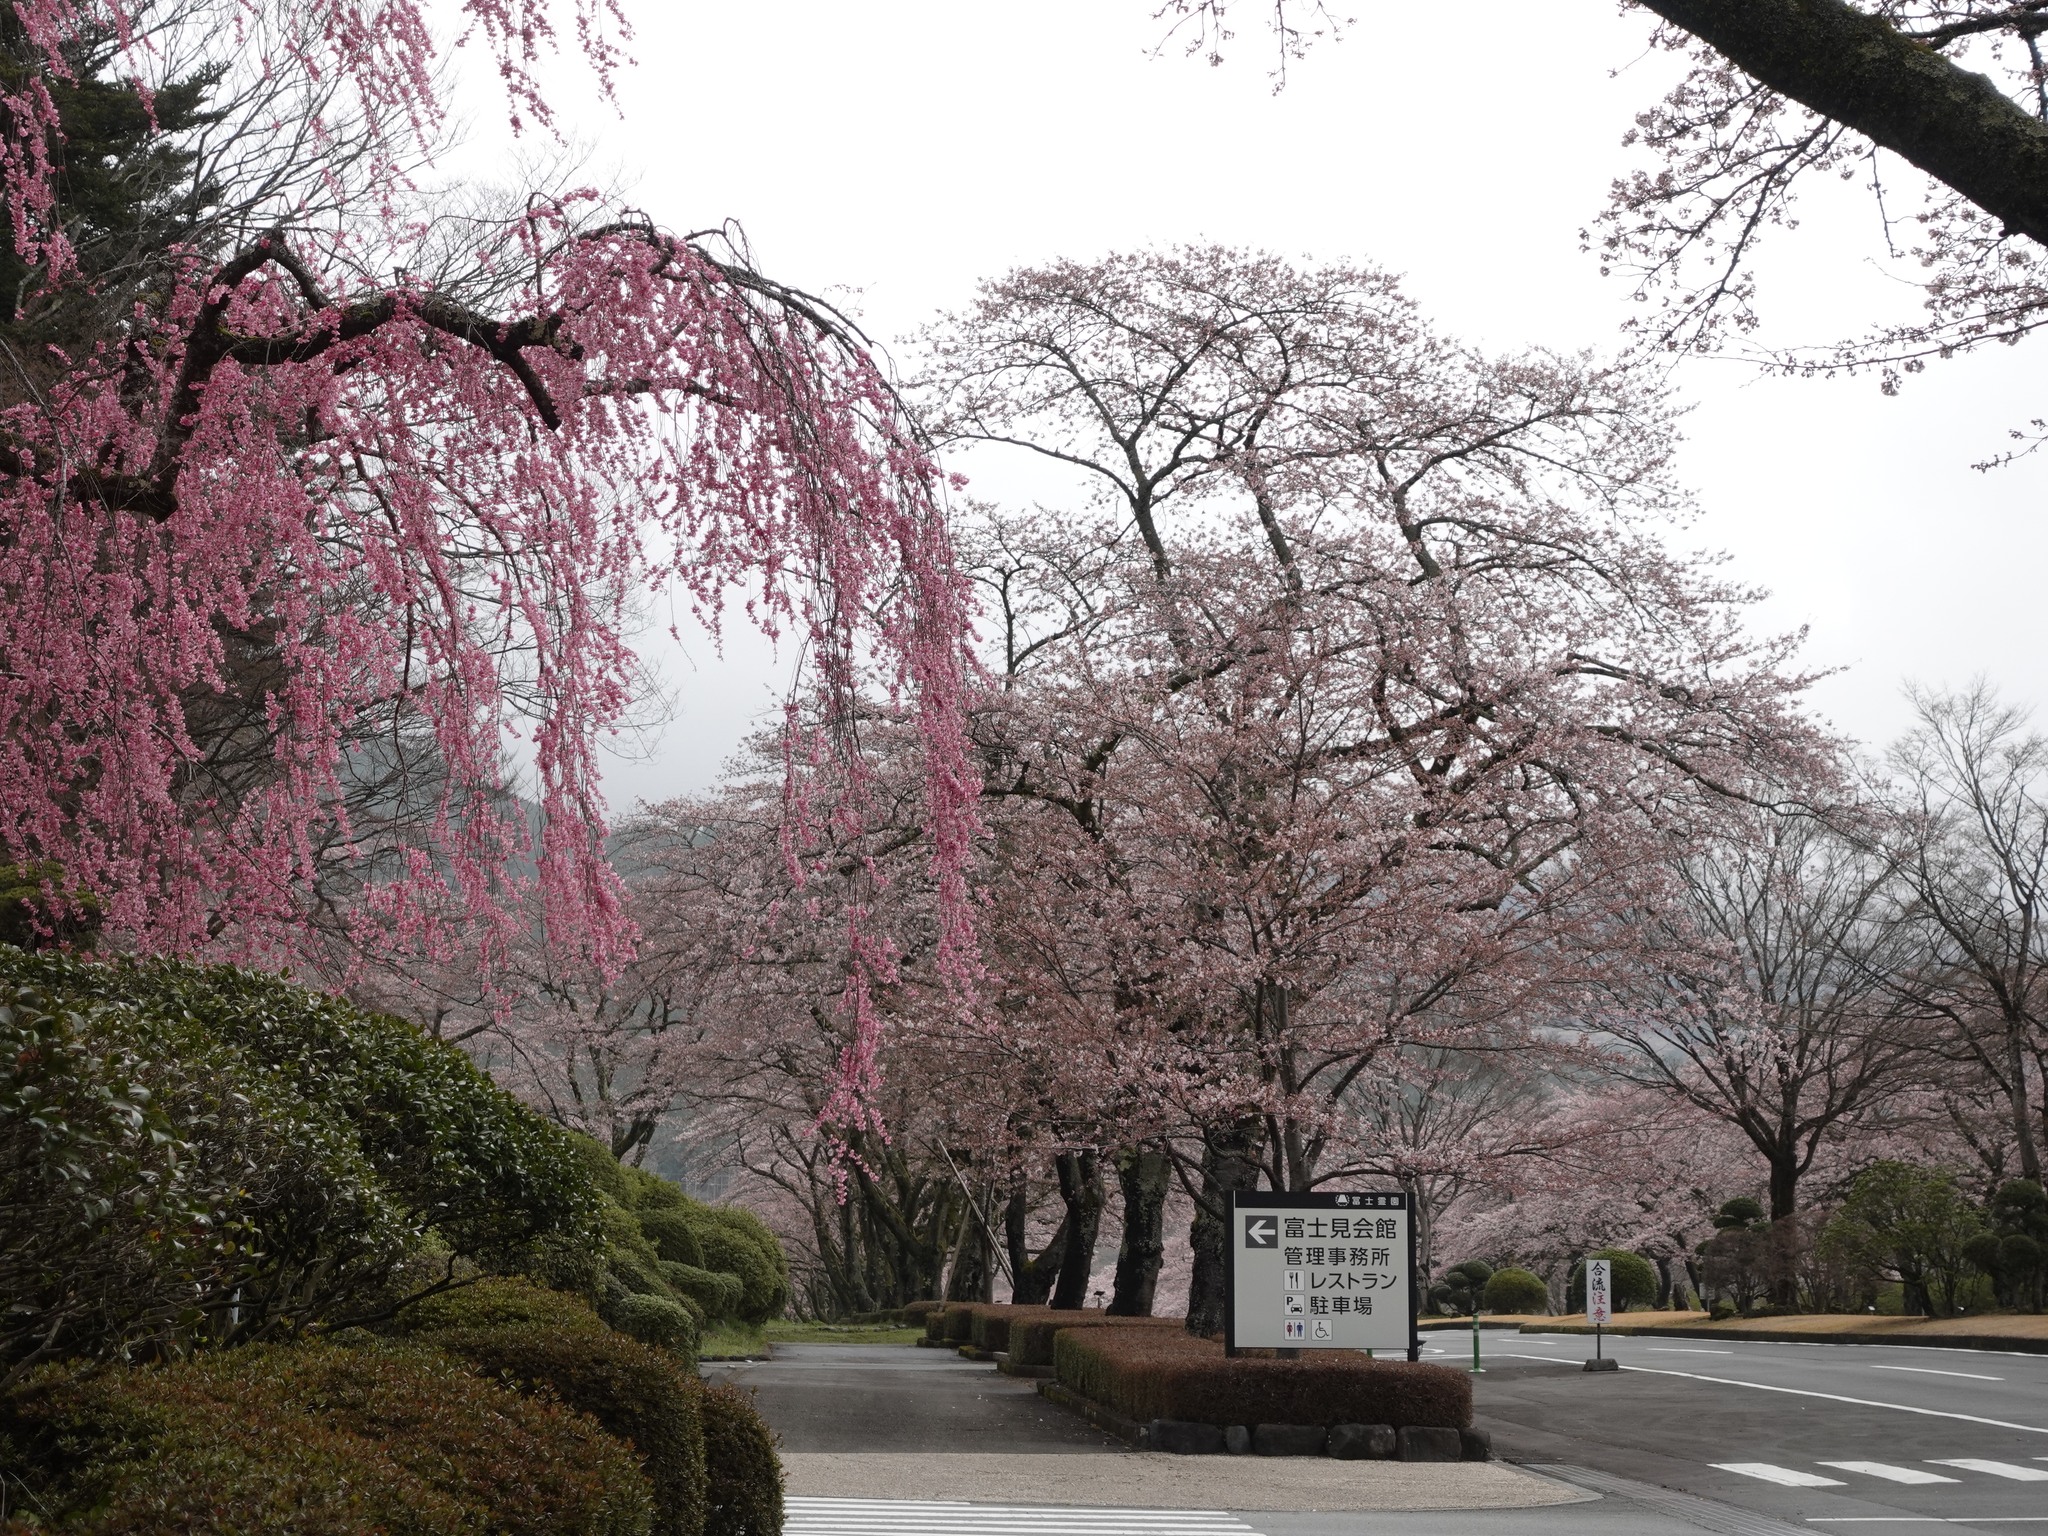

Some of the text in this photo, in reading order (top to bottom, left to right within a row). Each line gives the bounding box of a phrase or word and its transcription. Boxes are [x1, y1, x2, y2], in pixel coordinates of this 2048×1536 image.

[1284, 1217, 1397, 1239] 富士見会館
[1284, 1246, 1390, 1266] 管理事務所
[1311, 1273, 1397, 1290] レストラン
[1286, 1296, 1293, 1305] P
[1591, 1262, 1606, 1321] 合流注意
[1310, 1296, 1373, 1315] 駐車場
